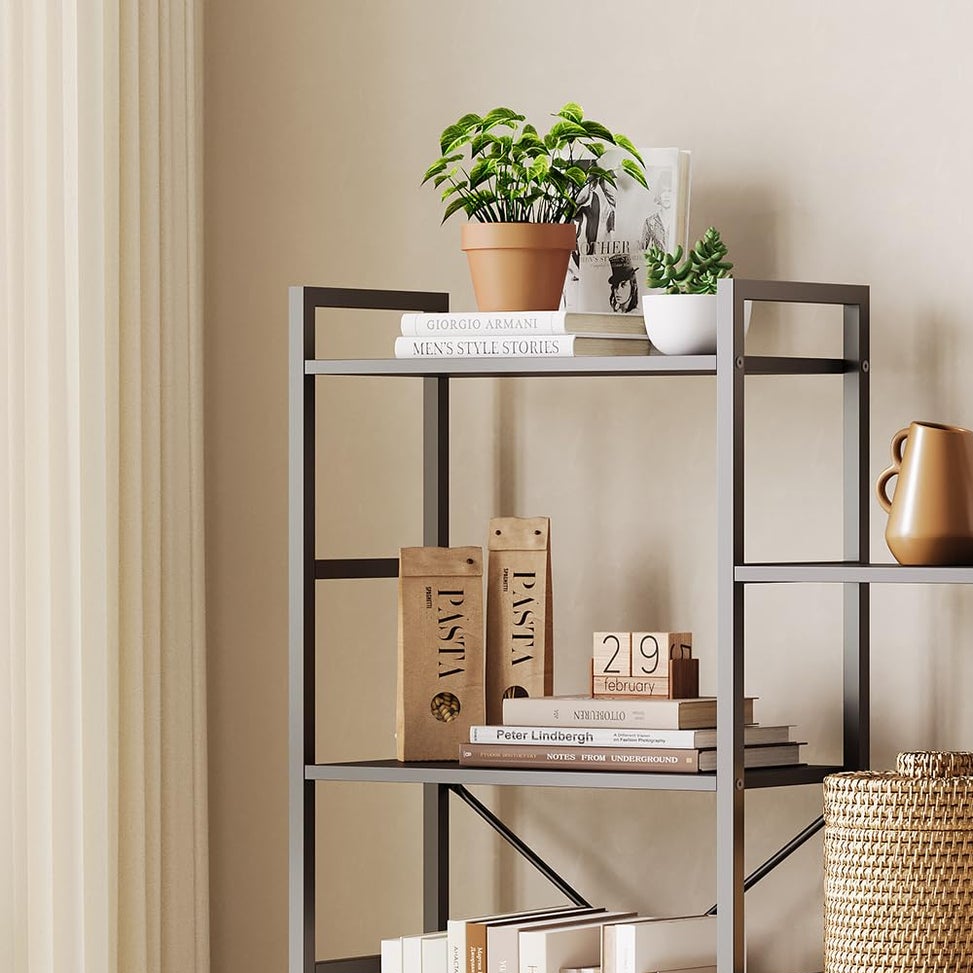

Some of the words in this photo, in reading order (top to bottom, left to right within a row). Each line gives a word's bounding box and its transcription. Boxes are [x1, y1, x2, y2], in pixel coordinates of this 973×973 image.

[580, 240, 630, 256] OTHER
[426, 319, 481, 330] GIORGIO
[485, 318, 538, 329] ARMANI
[413, 341, 453, 355] MEN'S
[457, 341, 499, 355] STYLE
[502, 340, 559, 354] STORIES
[511, 571, 536, 666] PASTA
[437, 589, 466, 679] PASTA
[604, 677, 656, 696] february
[496, 729, 529, 742] Peter
[531, 731, 594, 745] Lindbergh
[546, 752, 576, 761] NOTES
[581, 754, 606, 762] FROM
[611, 755, 679, 764] UNDERGROUND
